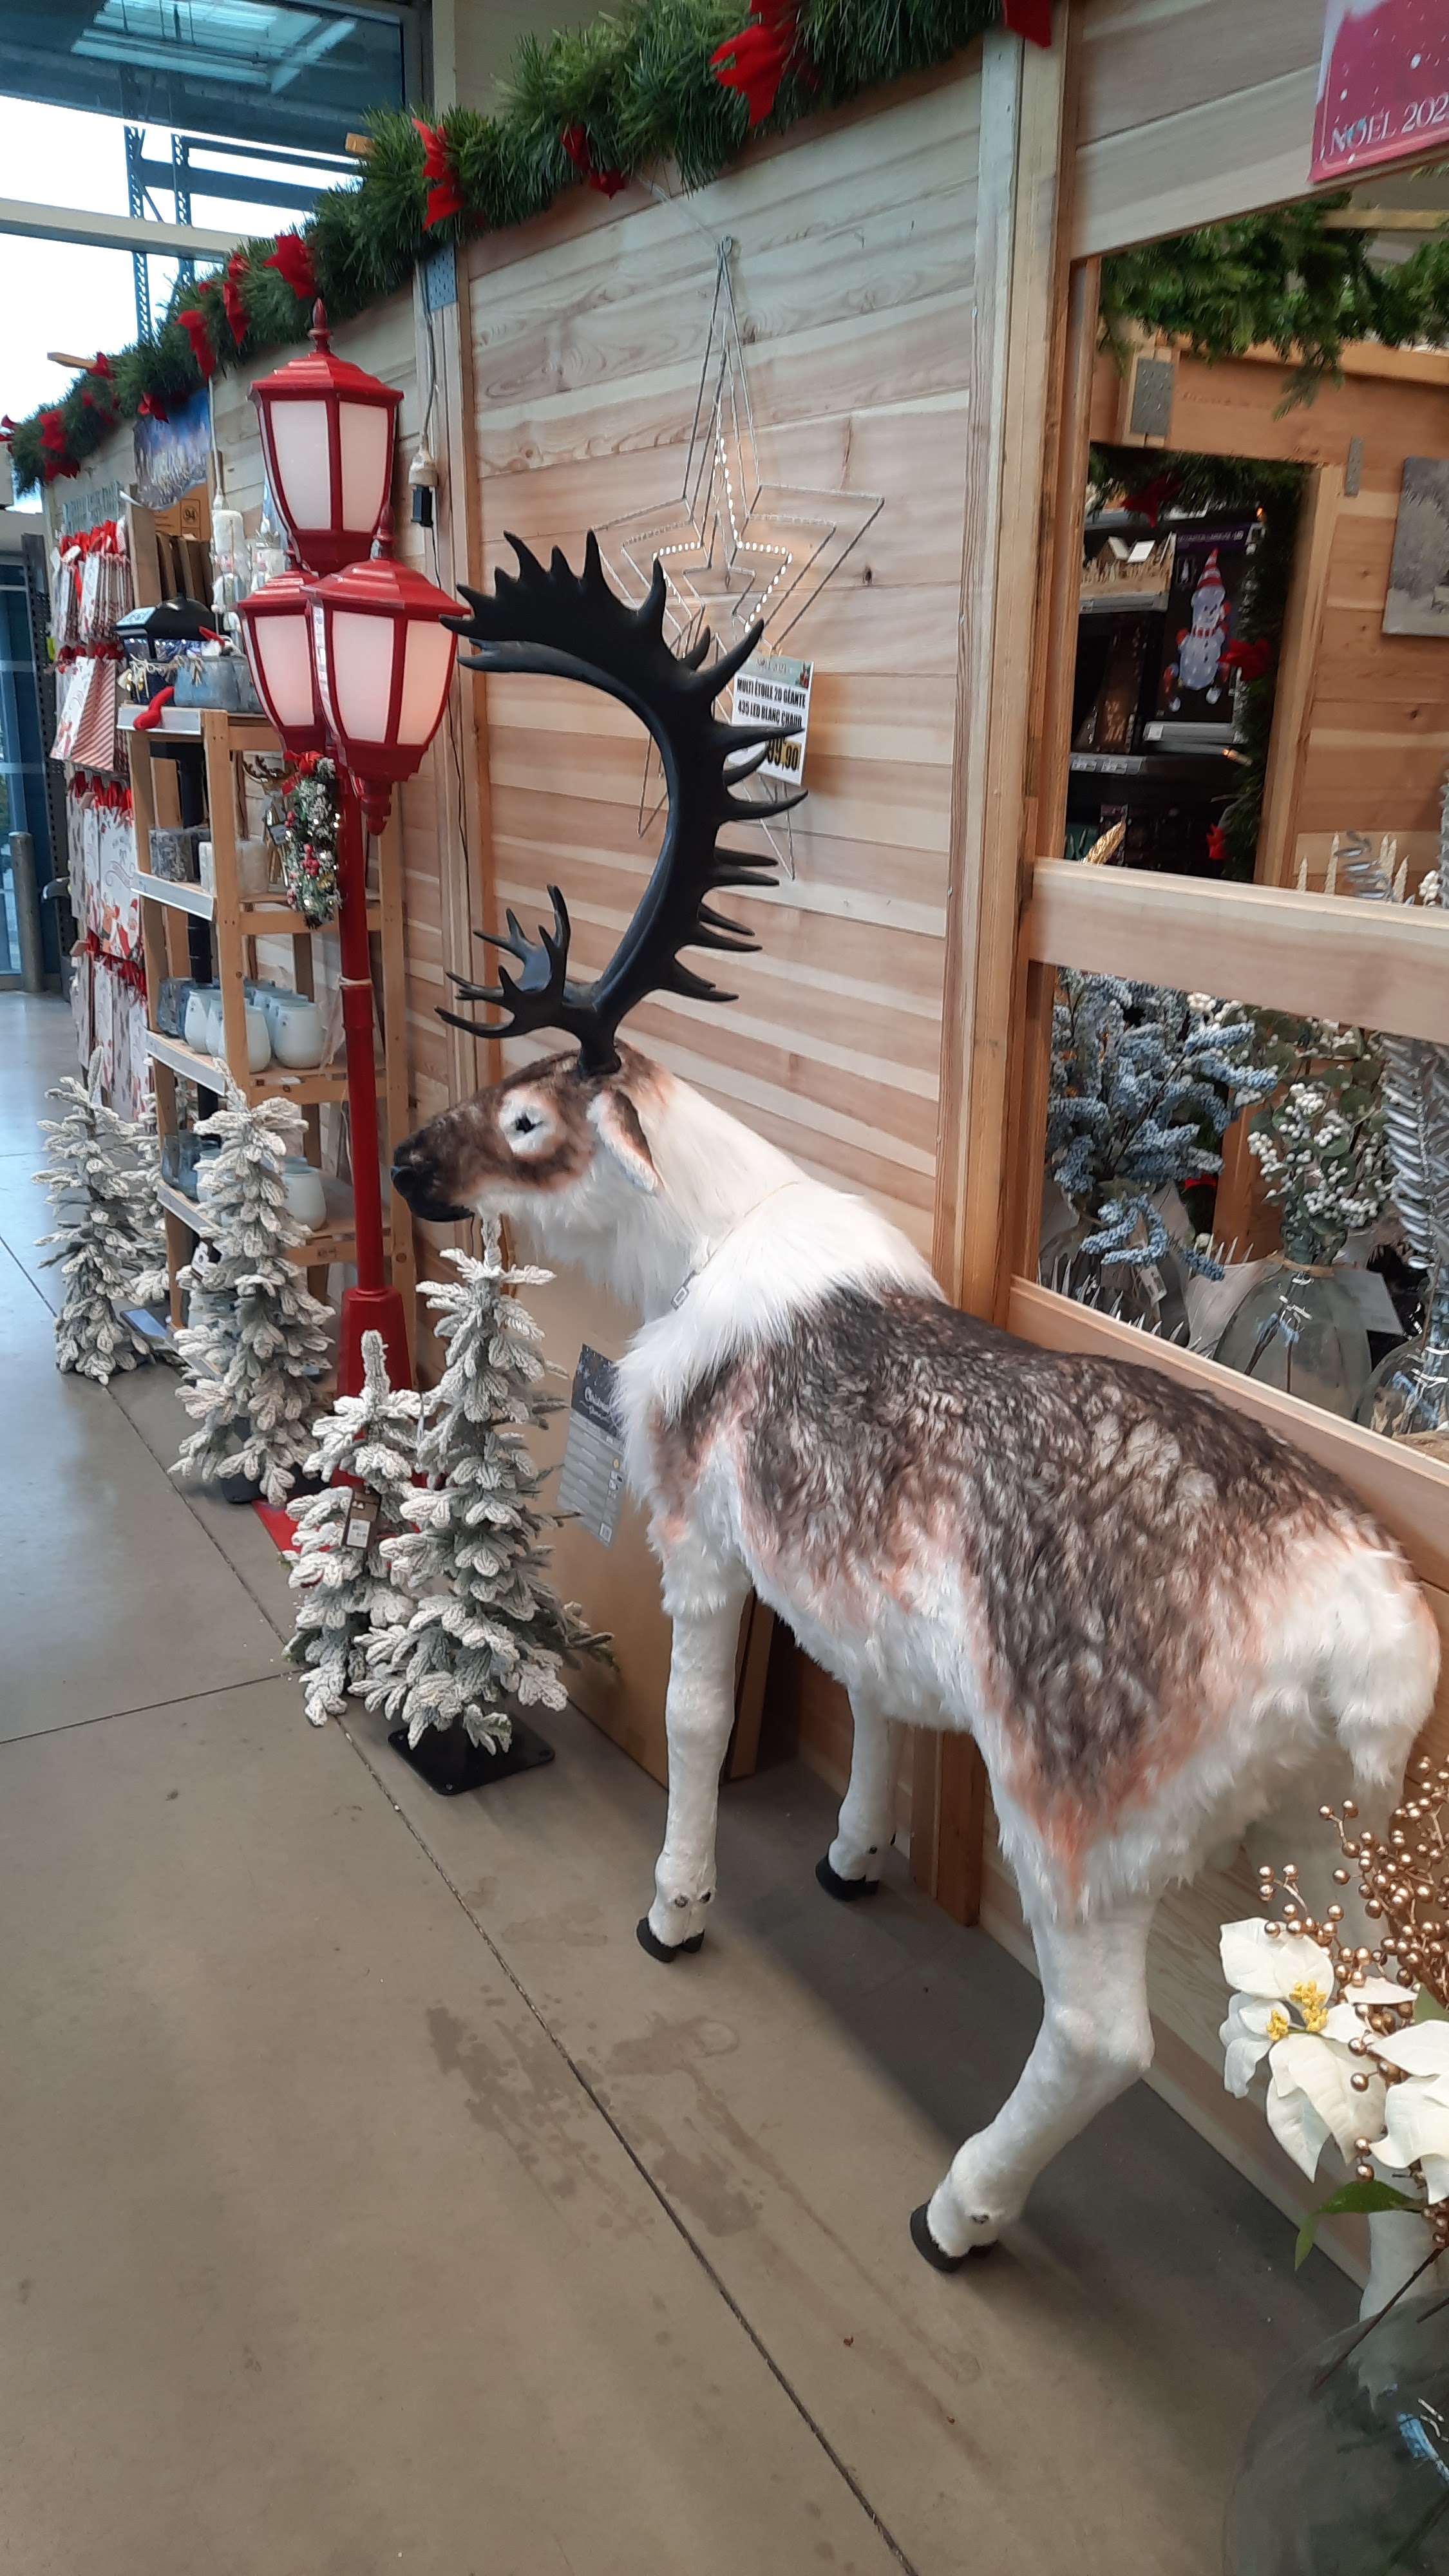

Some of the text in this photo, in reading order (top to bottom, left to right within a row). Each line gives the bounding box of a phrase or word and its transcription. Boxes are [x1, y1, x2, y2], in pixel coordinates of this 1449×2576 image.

[1401, 91, 1449, 134] 202
[737, 677, 806, 709] MULTI ÉTOILE 2D GÉANTE
[750, 701, 761, 719] LED
[781, 710, 803, 728] CHAUD
